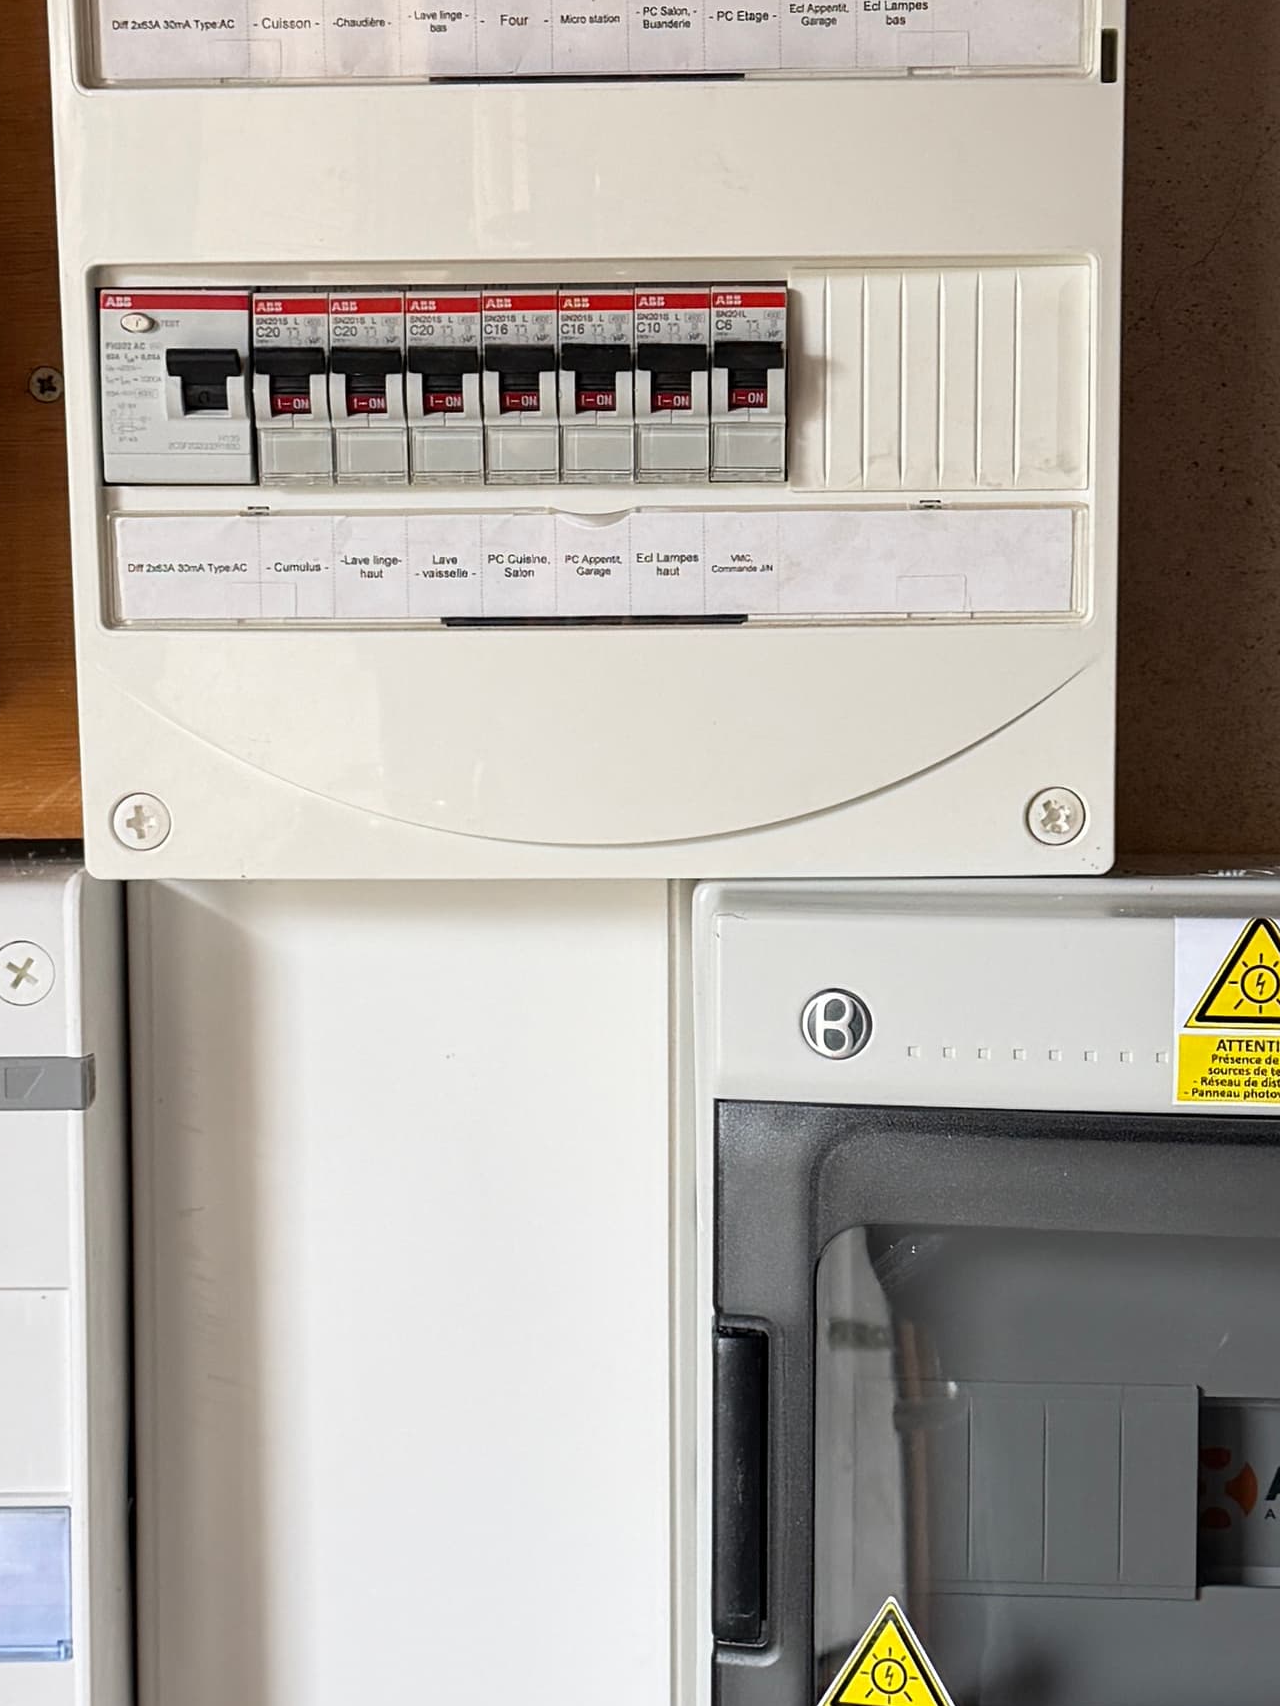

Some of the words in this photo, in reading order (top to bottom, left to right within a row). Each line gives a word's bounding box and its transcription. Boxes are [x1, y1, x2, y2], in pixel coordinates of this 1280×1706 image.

[643, 7, 658, 16] PC
[884, 0, 928, 12] Lampes
[414, 10, 438, 21] Lave
[440, 10, 463, 22] linge
[500, 15, 528, 26] Four
[560, 14, 586, 25] Micro
[588, 14, 620, 24] station
[716, 11, 733, 22] PC
[737, 11, 769, 23] Etage
[801, 16, 837, 27] Garage
[885, 14, 906, 25] bas
[261, 17, 311, 30] Cuisson
[430, 23, 447, 33] bas
[643, 19, 691, 29] Buanderie
[432, 555, 457, 565] Lave
[488, 554, 504, 564] PC
[657, 553, 699, 565] Lampes
[273, 561, 321, 573] Cumulus
[422, 567, 468, 578] vaisselle
[504, 567, 535, 578] Salon
[576, 567, 611, 578] Garage
[656, 566, 680, 577] haut
[712, 564, 757, 573] Commande
[360, 568, 382, 579] haut
[1211, 1054, 1262, 1066] Présence
[1264, 1055, 1279, 1065] de
[1208, 1067, 1251, 1076] sources
[1253, 1066, 1267, 1076] de
[1200, 1076, 1241, 1087] Réseau
[1244, 1077, 1258, 1087] de
[1191, 1087, 1240, 1099] Panneau
